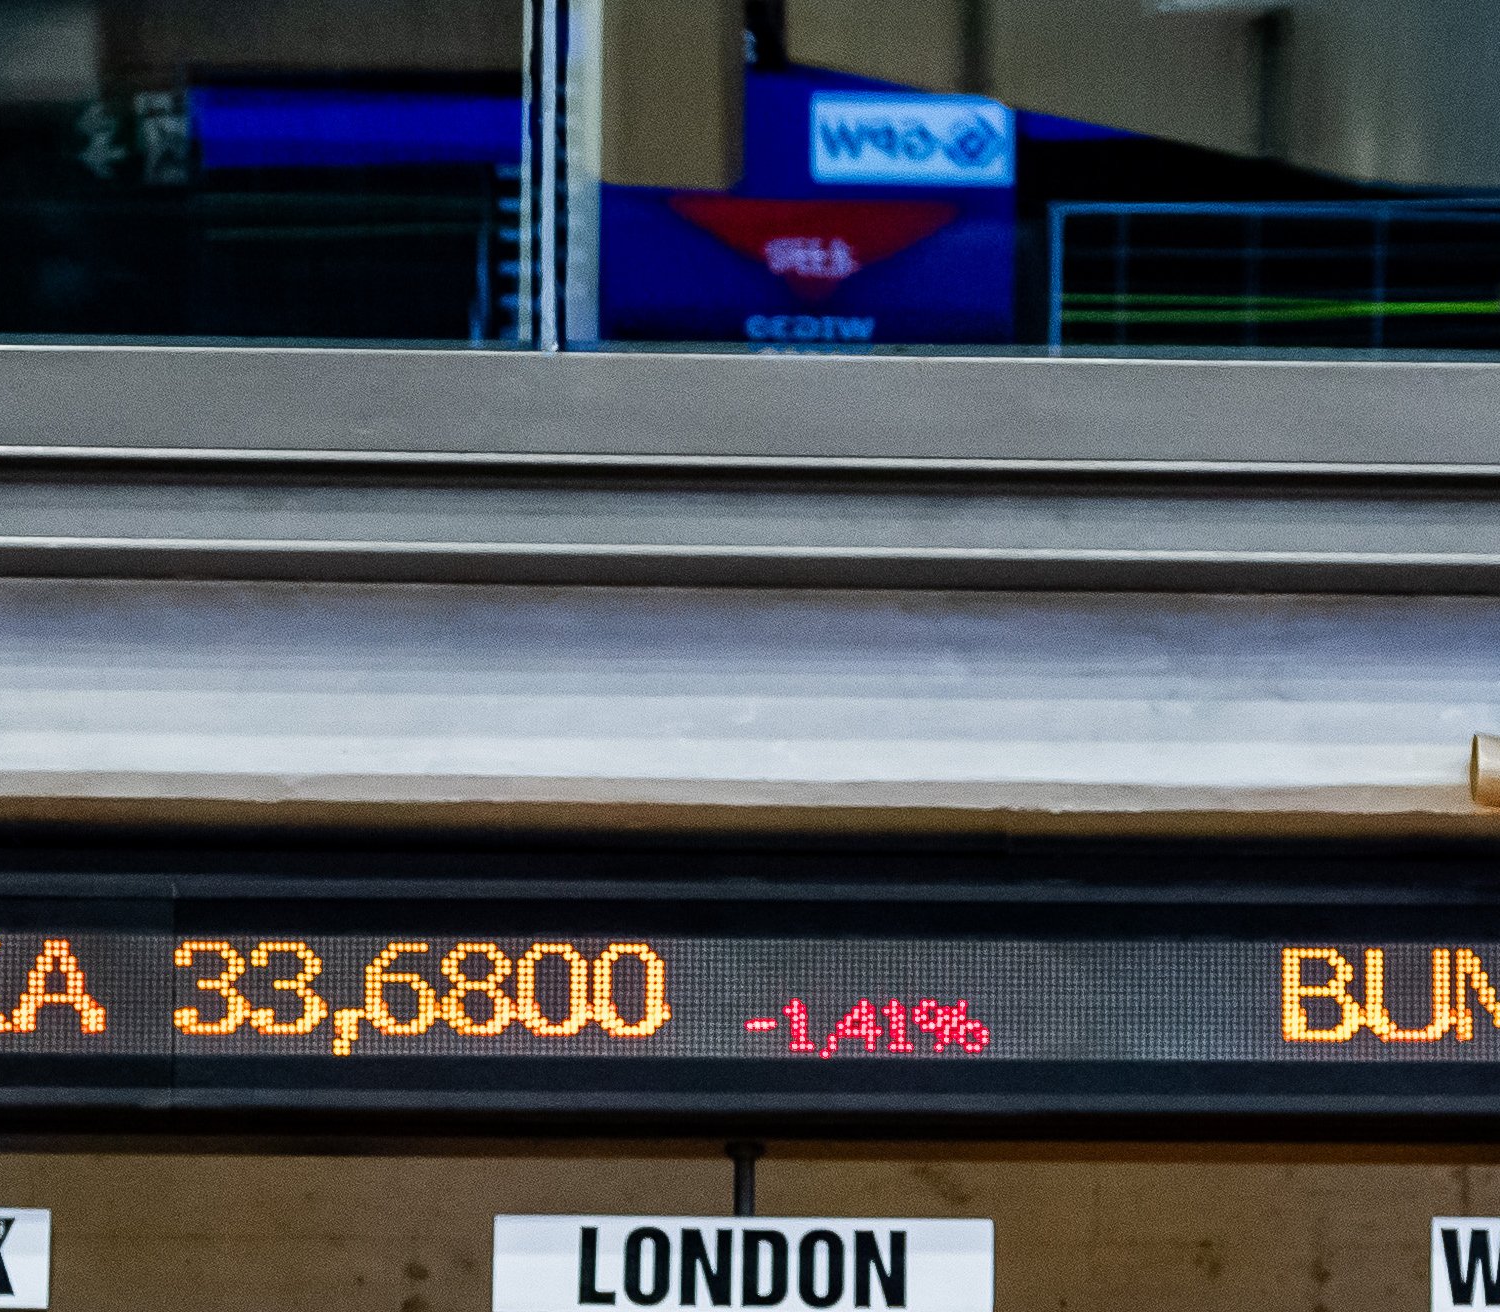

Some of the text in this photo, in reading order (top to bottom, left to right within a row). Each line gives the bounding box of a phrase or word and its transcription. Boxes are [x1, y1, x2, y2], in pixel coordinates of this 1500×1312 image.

[174, 941, 671, 1056] 33,6800
[745, 998, 989, 1058] -1,41%
[579, 1227, 906, 1308] LONDON
